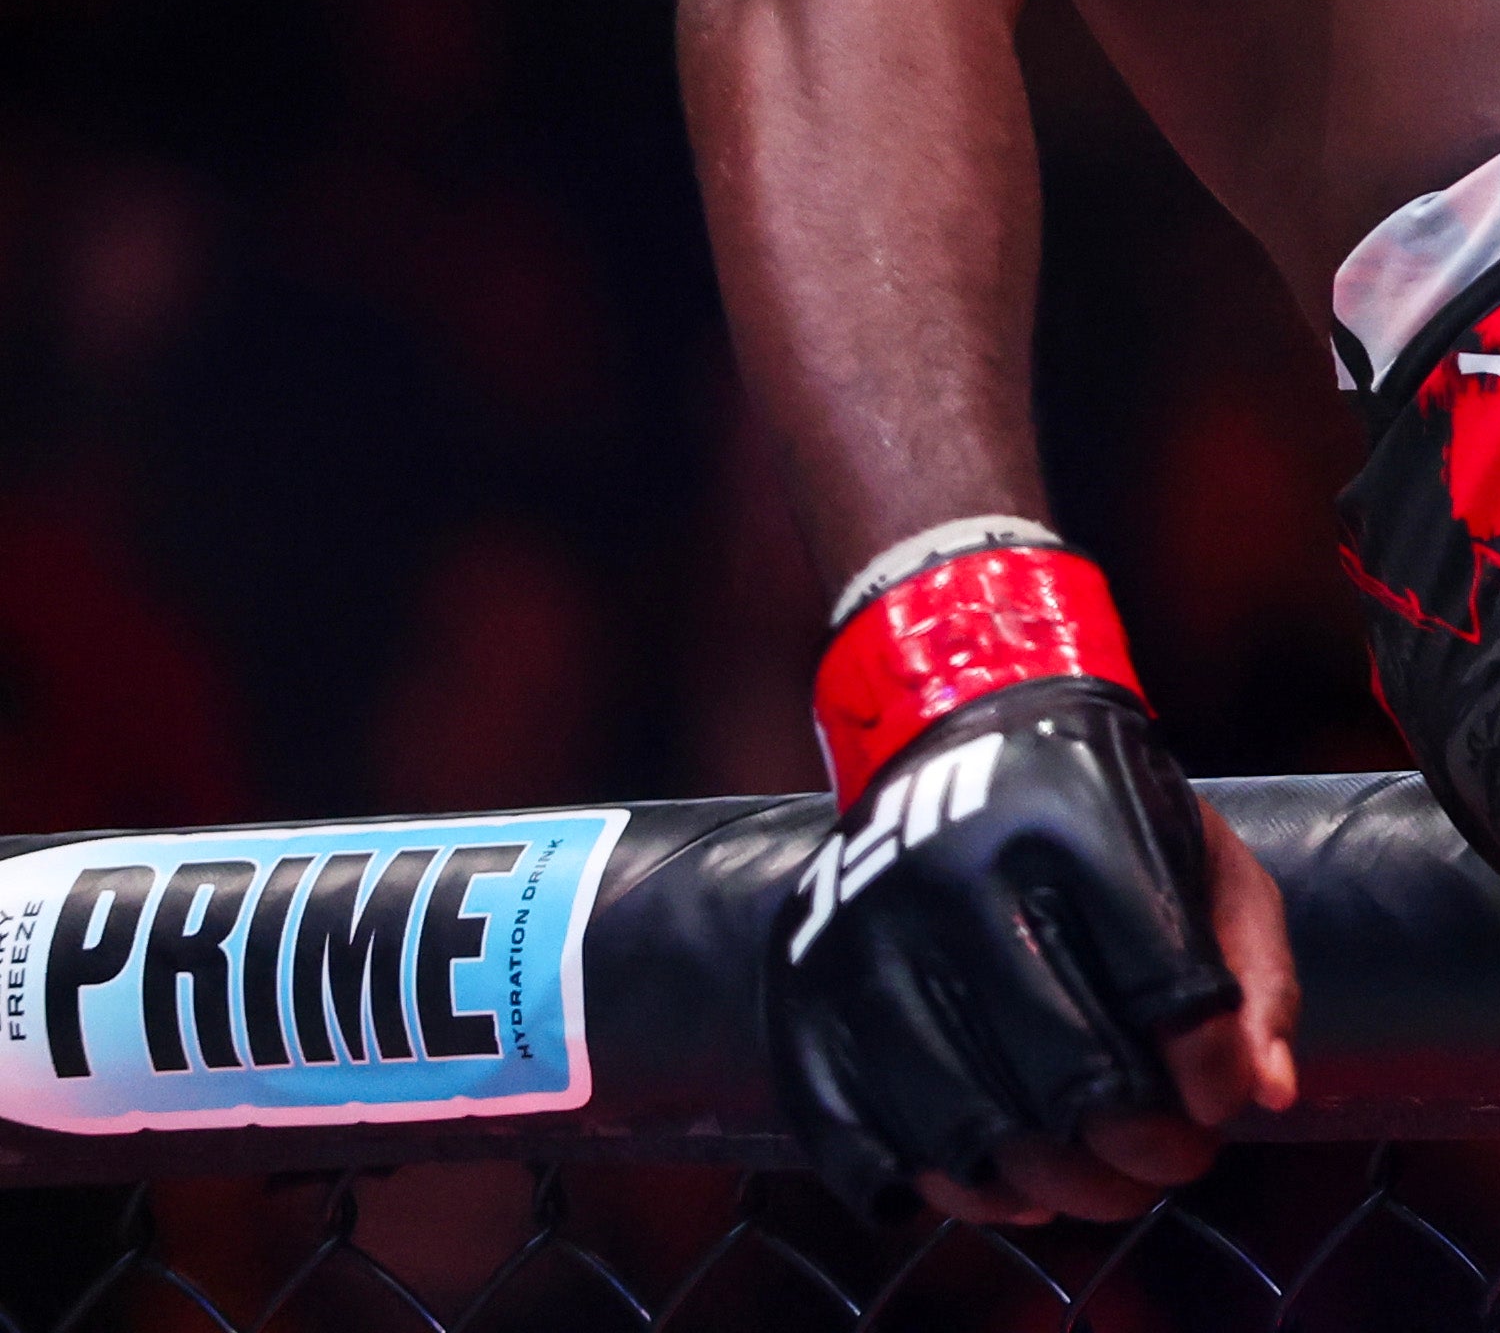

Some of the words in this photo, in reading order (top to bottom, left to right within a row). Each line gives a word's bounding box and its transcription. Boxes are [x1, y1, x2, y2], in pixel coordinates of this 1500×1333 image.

[7, 900, 44, 1041] FREEZE
[43, 840, 534, 1079] PRIME
[509, 909, 533, 1060] HYDRATION
[521, 838, 564, 902] DRINK
